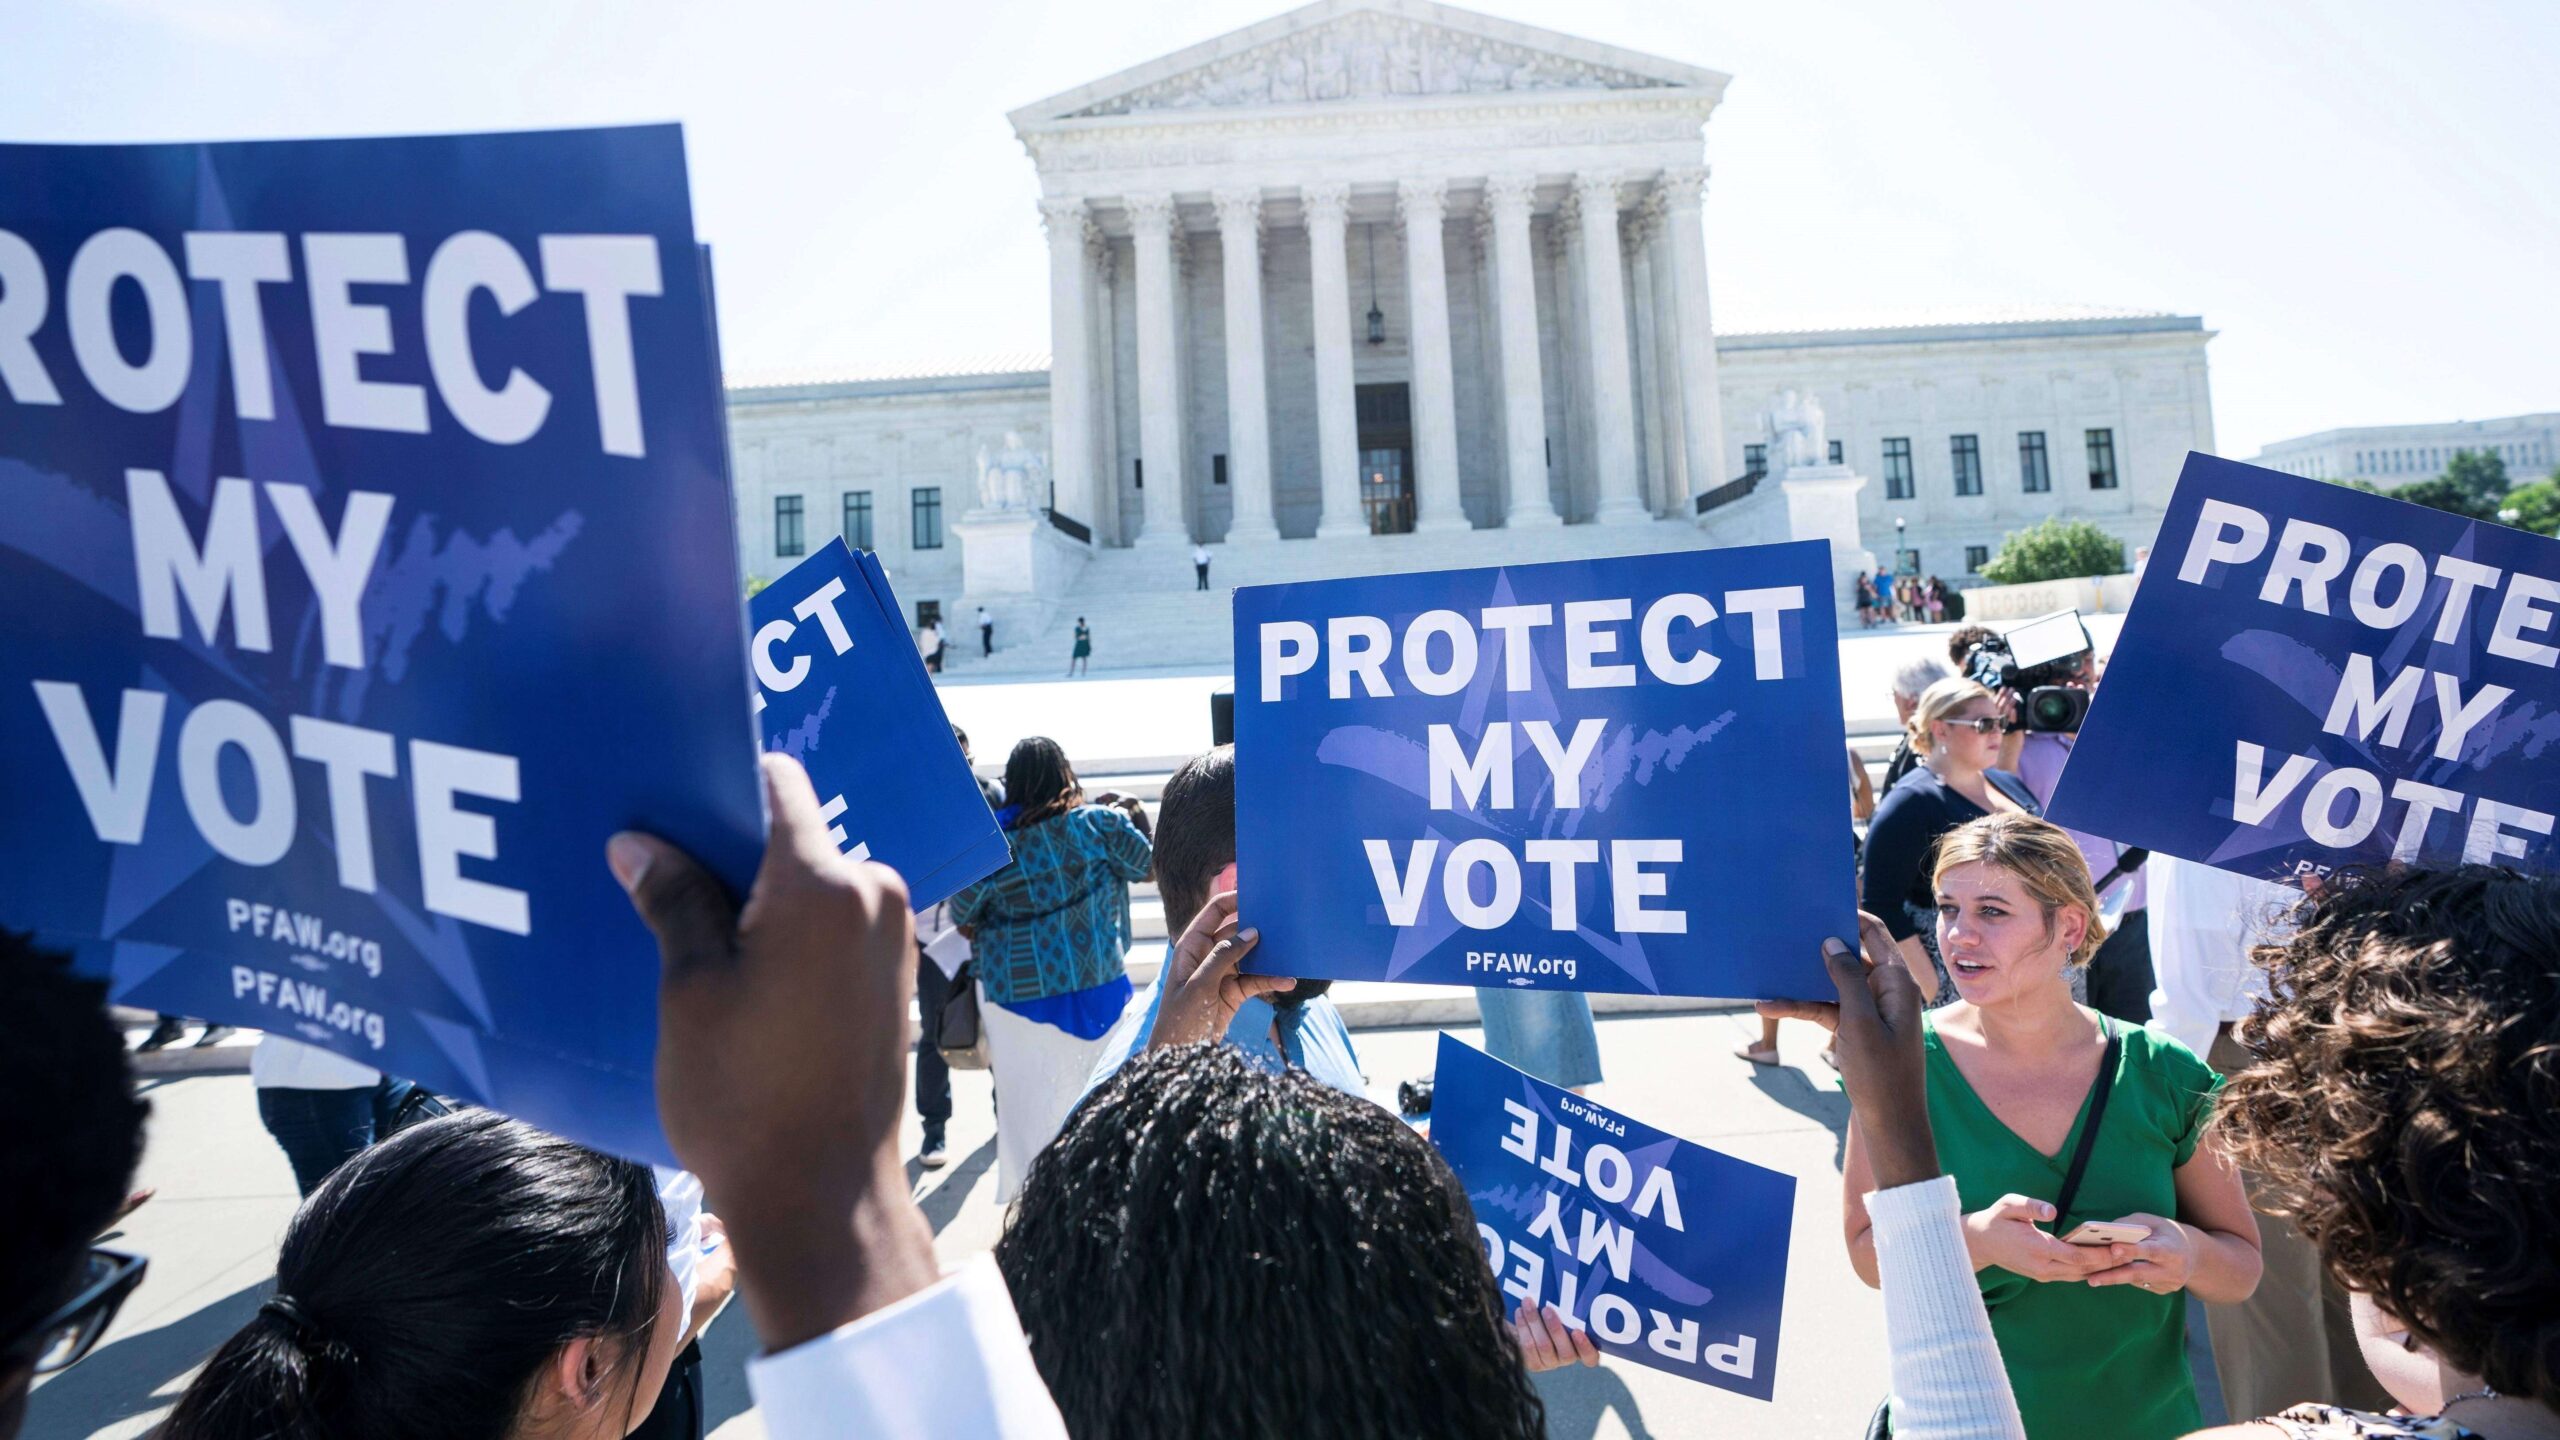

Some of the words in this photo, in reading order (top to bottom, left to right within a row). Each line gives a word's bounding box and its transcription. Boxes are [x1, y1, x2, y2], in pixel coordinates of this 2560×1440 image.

[127, 469, 395, 669] MY
[1260, 585, 1805, 703] PROTECT
[2322, 652, 2515, 762] MY
[34, 681, 530, 935] VOTE
[1428, 718, 1608, 811] MY
[1362, 838, 1687, 934] VOTE
[227, 899, 382, 977] PFAW.org
[1466, 951, 1577, 980] PFAW.org
[232, 966, 385, 1049] PFAW.org
[1561, 1097, 1625, 1137] PFAW.org
[1501, 1098, 1684, 1232] VOTE
[1527, 1190, 1635, 1283] MY
